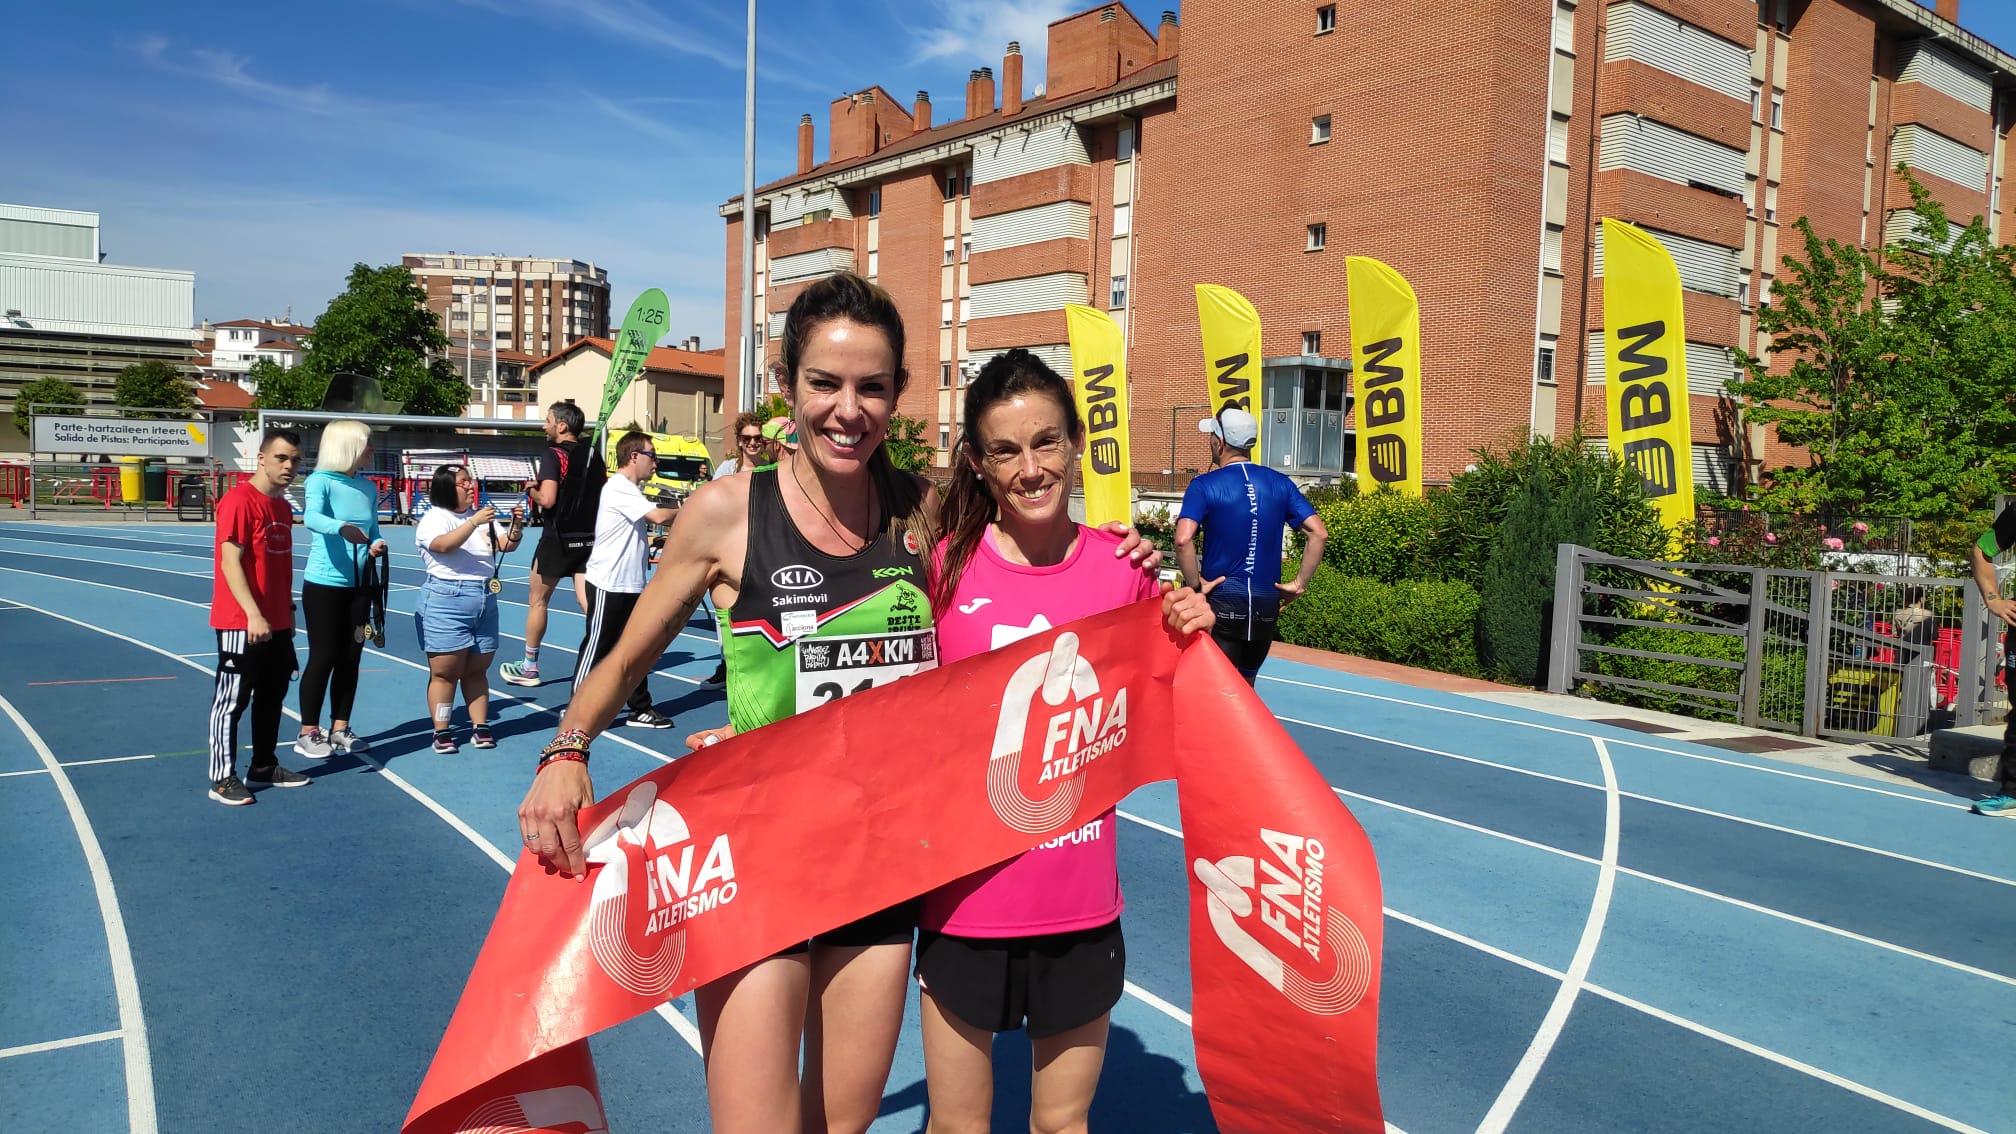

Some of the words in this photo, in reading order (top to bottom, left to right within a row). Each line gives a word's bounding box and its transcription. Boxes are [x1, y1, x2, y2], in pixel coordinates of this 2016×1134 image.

[637, 307, 664, 325] 1:25
[54, 422, 149, 434] Parte-hartzaileen
[151, 425, 187, 435] irteera
[54, 432, 84, 443] Salida
[86, 434, 98, 443] de
[101, 435, 130, 444] Pistas:
[132, 436, 189, 446] Participantes
[1244, 482, 1258, 515] Ardoi
[1243, 519, 1258, 575] Atletismo
[780, 571, 816, 585] KIA
[772, 593, 828, 607] Sakimóvil
[836, 638, 914, 666] A4XKM
[1042, 687, 1127, 763] FNA
[1038, 727, 1127, 784] ATLETISMO
[1259, 827, 1304, 948] FNA
[1303, 838, 1325, 964] ATLETISMO
[645, 881, 738, 937] ATLETISMO
